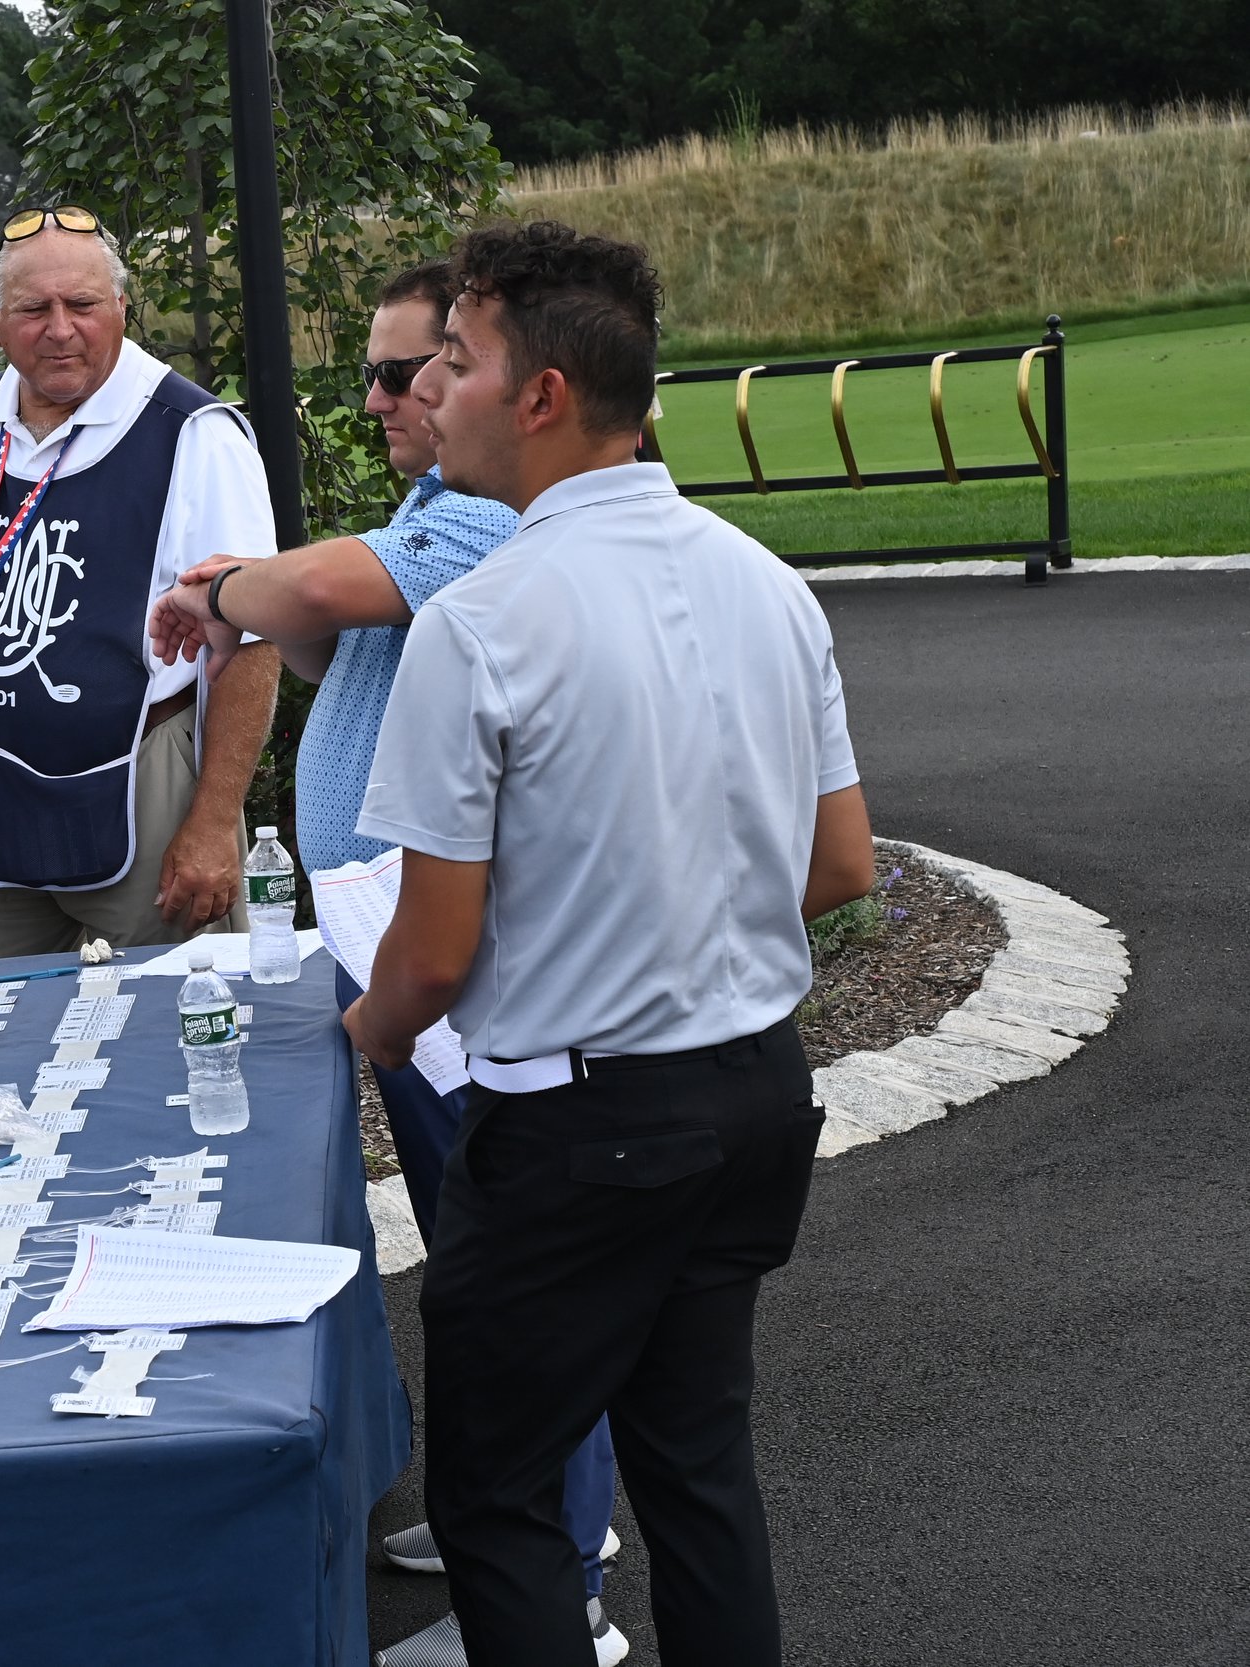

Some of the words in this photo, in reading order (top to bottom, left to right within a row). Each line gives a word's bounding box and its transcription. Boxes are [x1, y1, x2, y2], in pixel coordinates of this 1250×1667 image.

[267, 877, 290, 890] Poland
[269, 885, 291, 898] Spring
[185, 1016, 209, 1030] Poland
[186, 1025, 211, 1039] Spring
